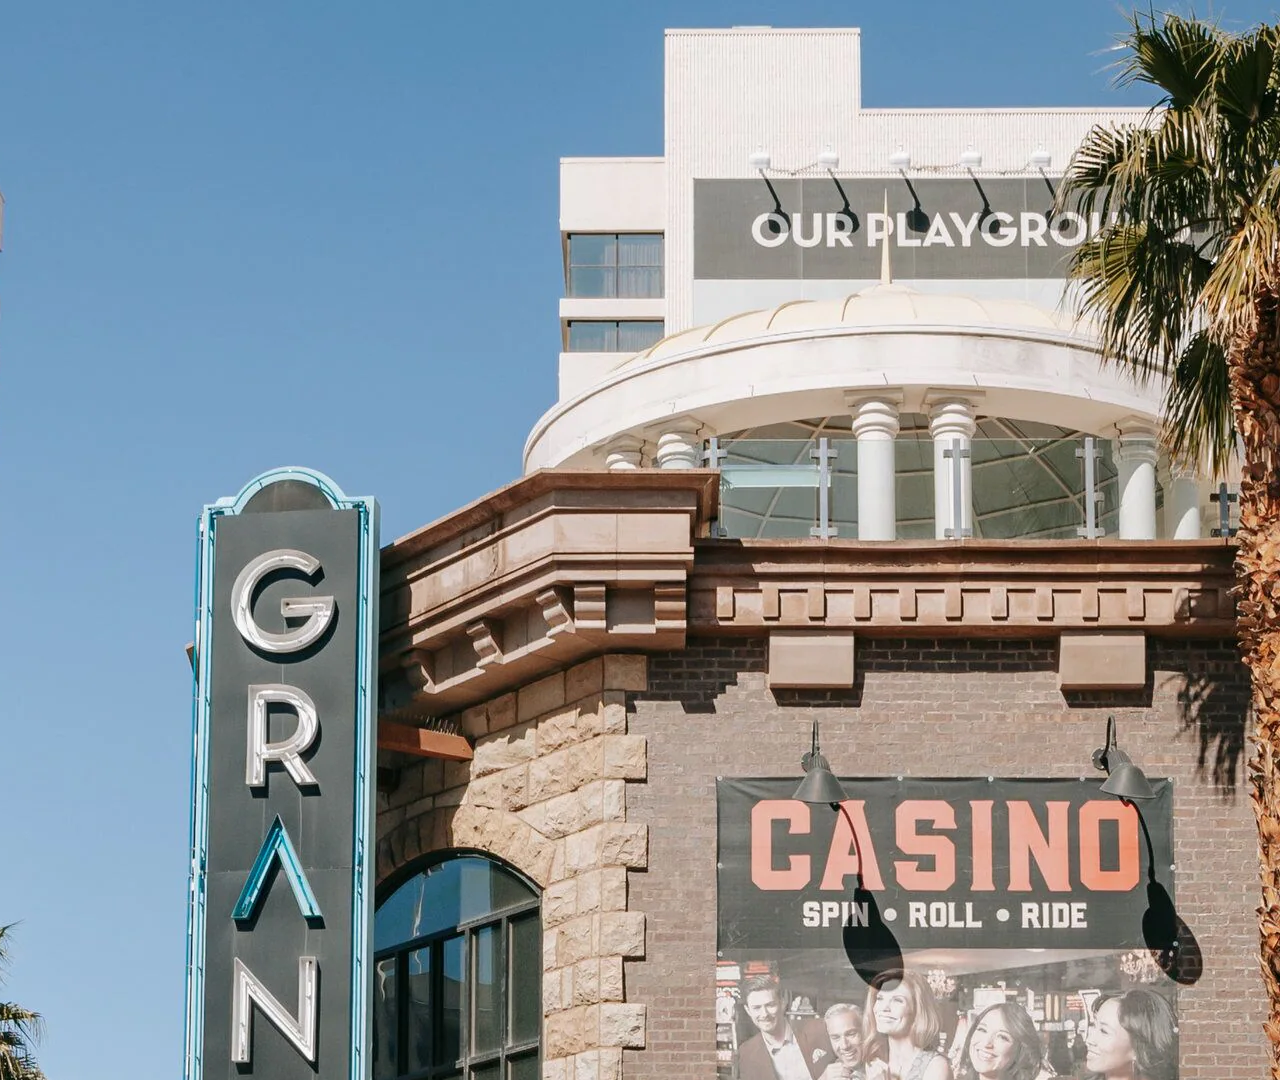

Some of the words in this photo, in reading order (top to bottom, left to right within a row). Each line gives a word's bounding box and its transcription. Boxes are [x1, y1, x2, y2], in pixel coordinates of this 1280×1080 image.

[751, 212, 854, 248] OUR
[750, 800, 1140, 892] CASINO
[802, 902, 869, 928] SPIN
[908, 902, 983, 928] ROLL
[1021, 902, 1088, 928] RIDE
